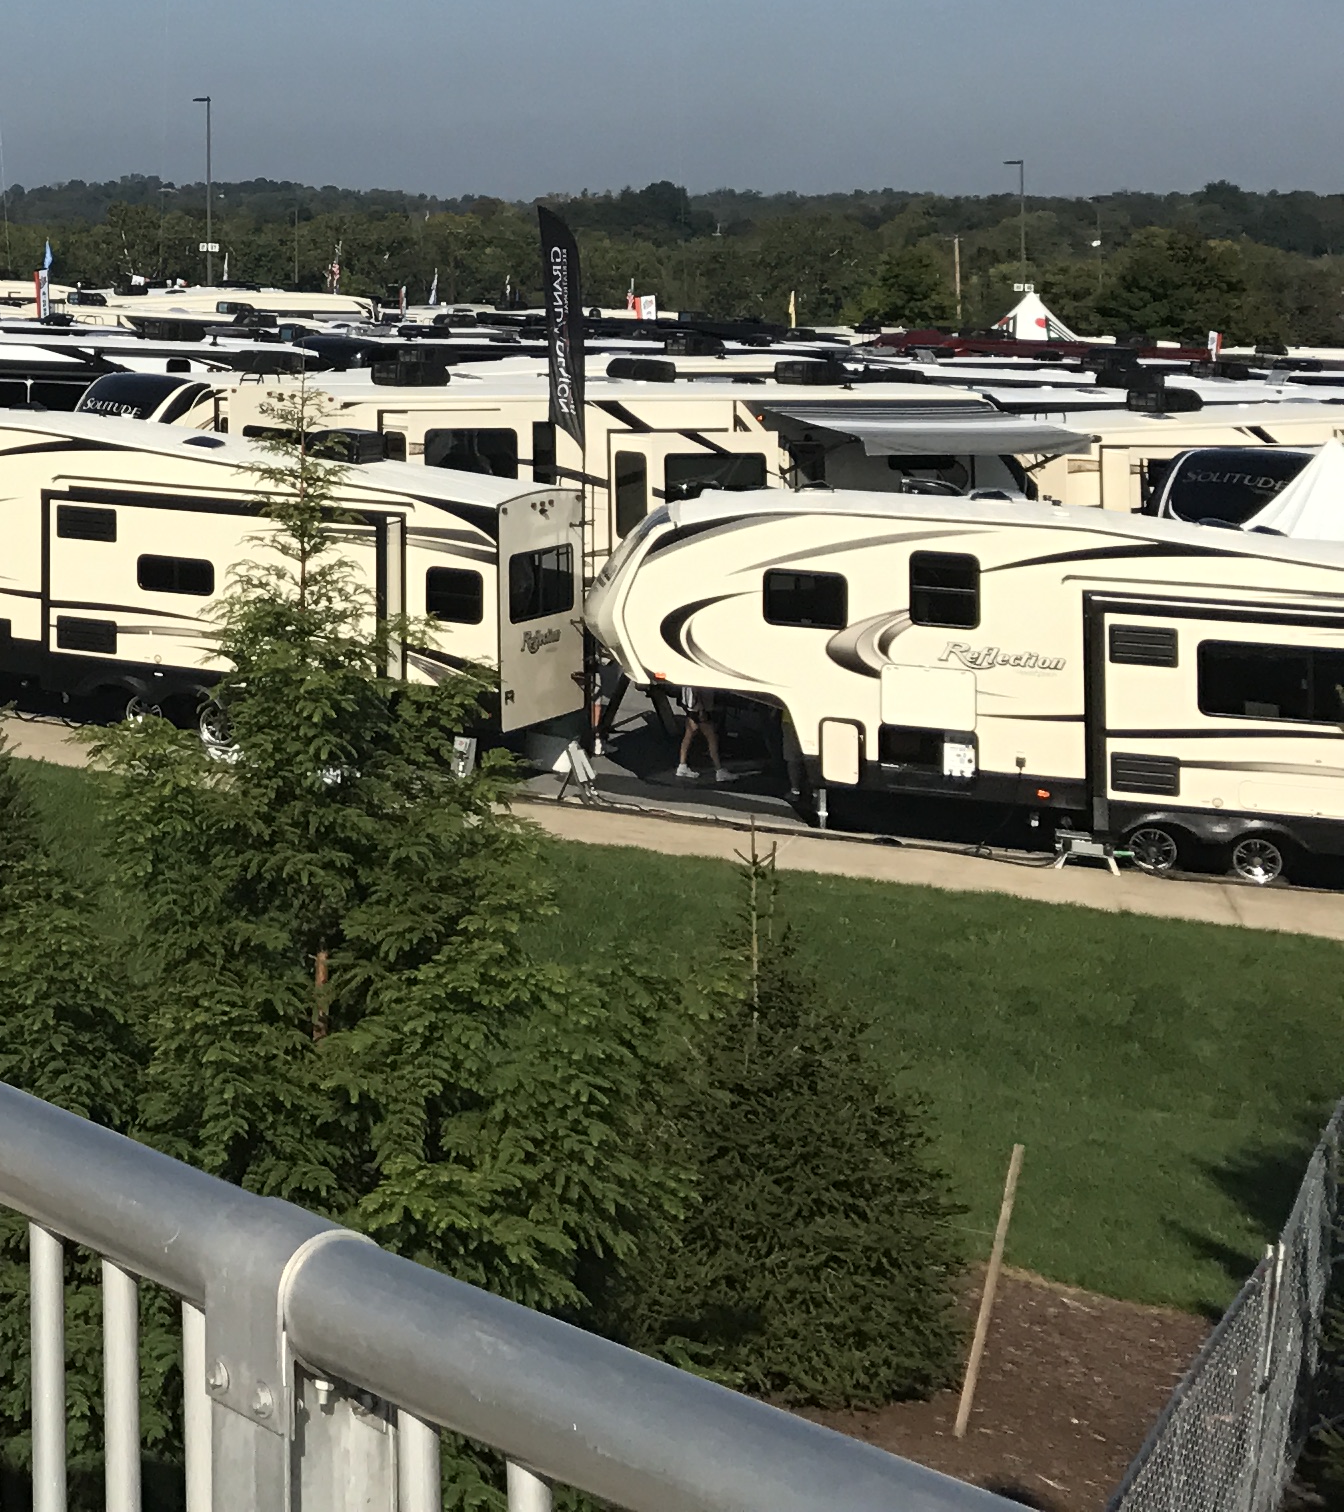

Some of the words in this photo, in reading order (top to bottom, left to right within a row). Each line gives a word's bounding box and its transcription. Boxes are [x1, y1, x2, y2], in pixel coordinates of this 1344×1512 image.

[83, 397, 143, 417] SOLITUDE
[1182, 470, 1290, 491] SOLITUDE
[520, 628, 561, 655] Reflection
[937, 641, 1067, 670] Reflection
